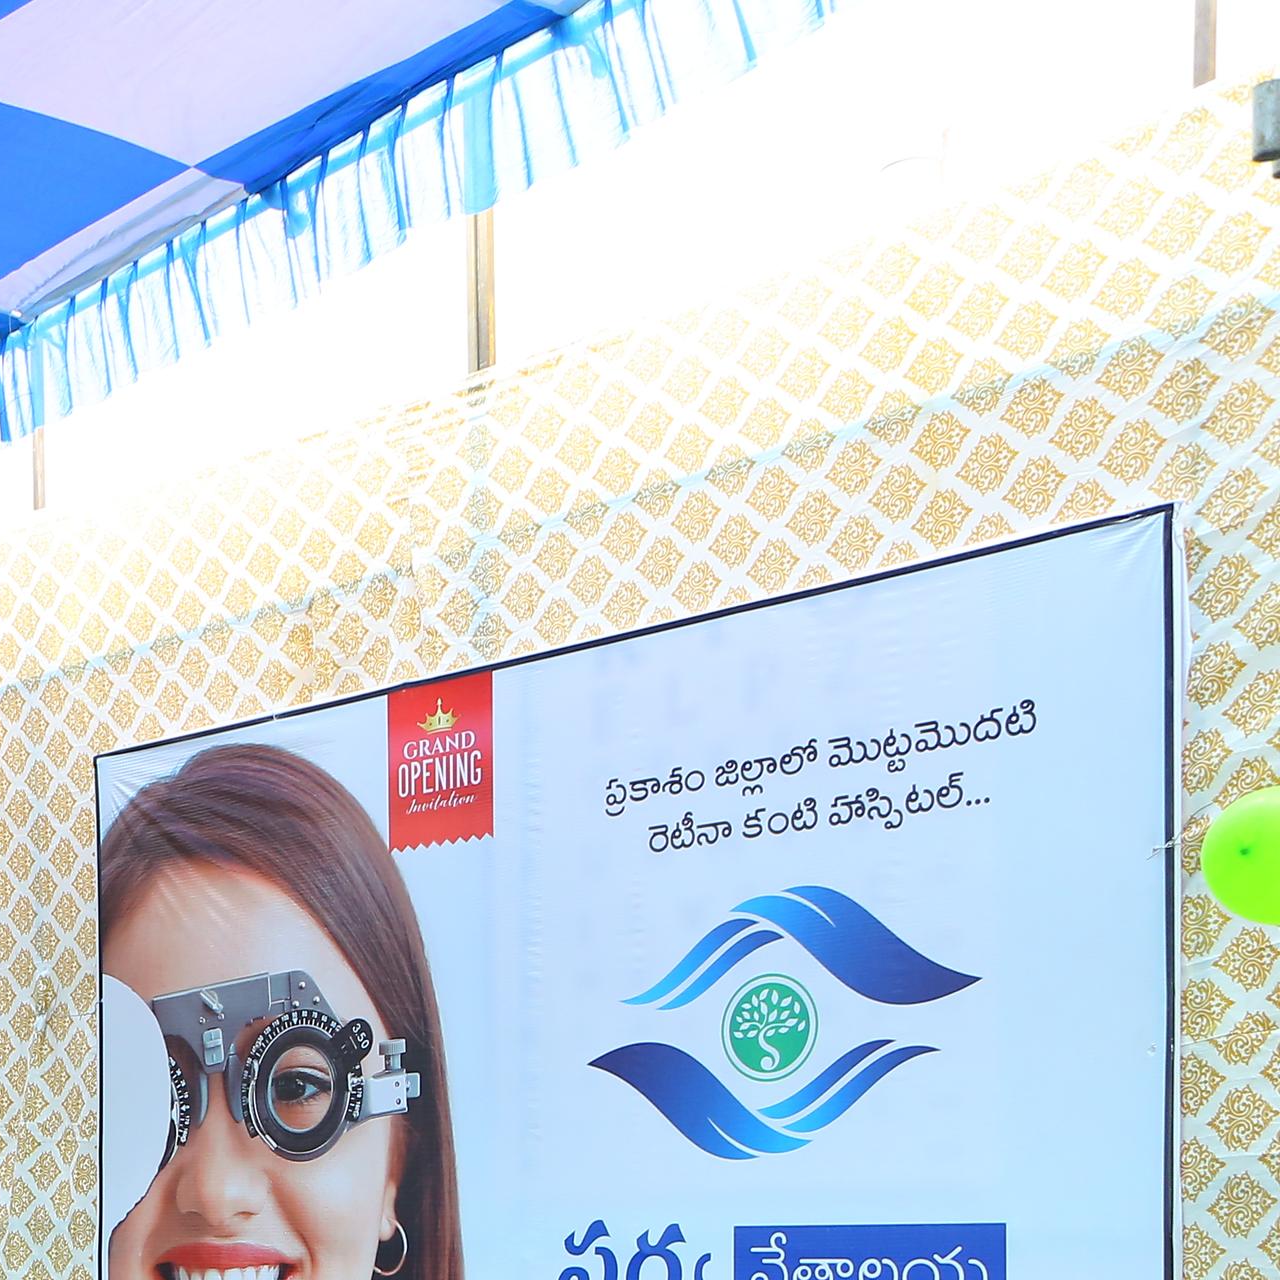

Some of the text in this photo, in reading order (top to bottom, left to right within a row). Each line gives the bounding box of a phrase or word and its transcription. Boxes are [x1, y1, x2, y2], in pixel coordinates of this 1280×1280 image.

[403, 730, 476, 761] GRAND
[605, 698, 1038, 817] ప్రకాశం జిల్లాలో మొట్టమొదటి
[398, 750, 482, 798] OPENING
[406, 790, 477, 815] Invitation
[648, 811, 733, 853] రెటీనా
[742, 797, 819, 839] కంటి
[352, 1023, 370, 1049] 3.50
